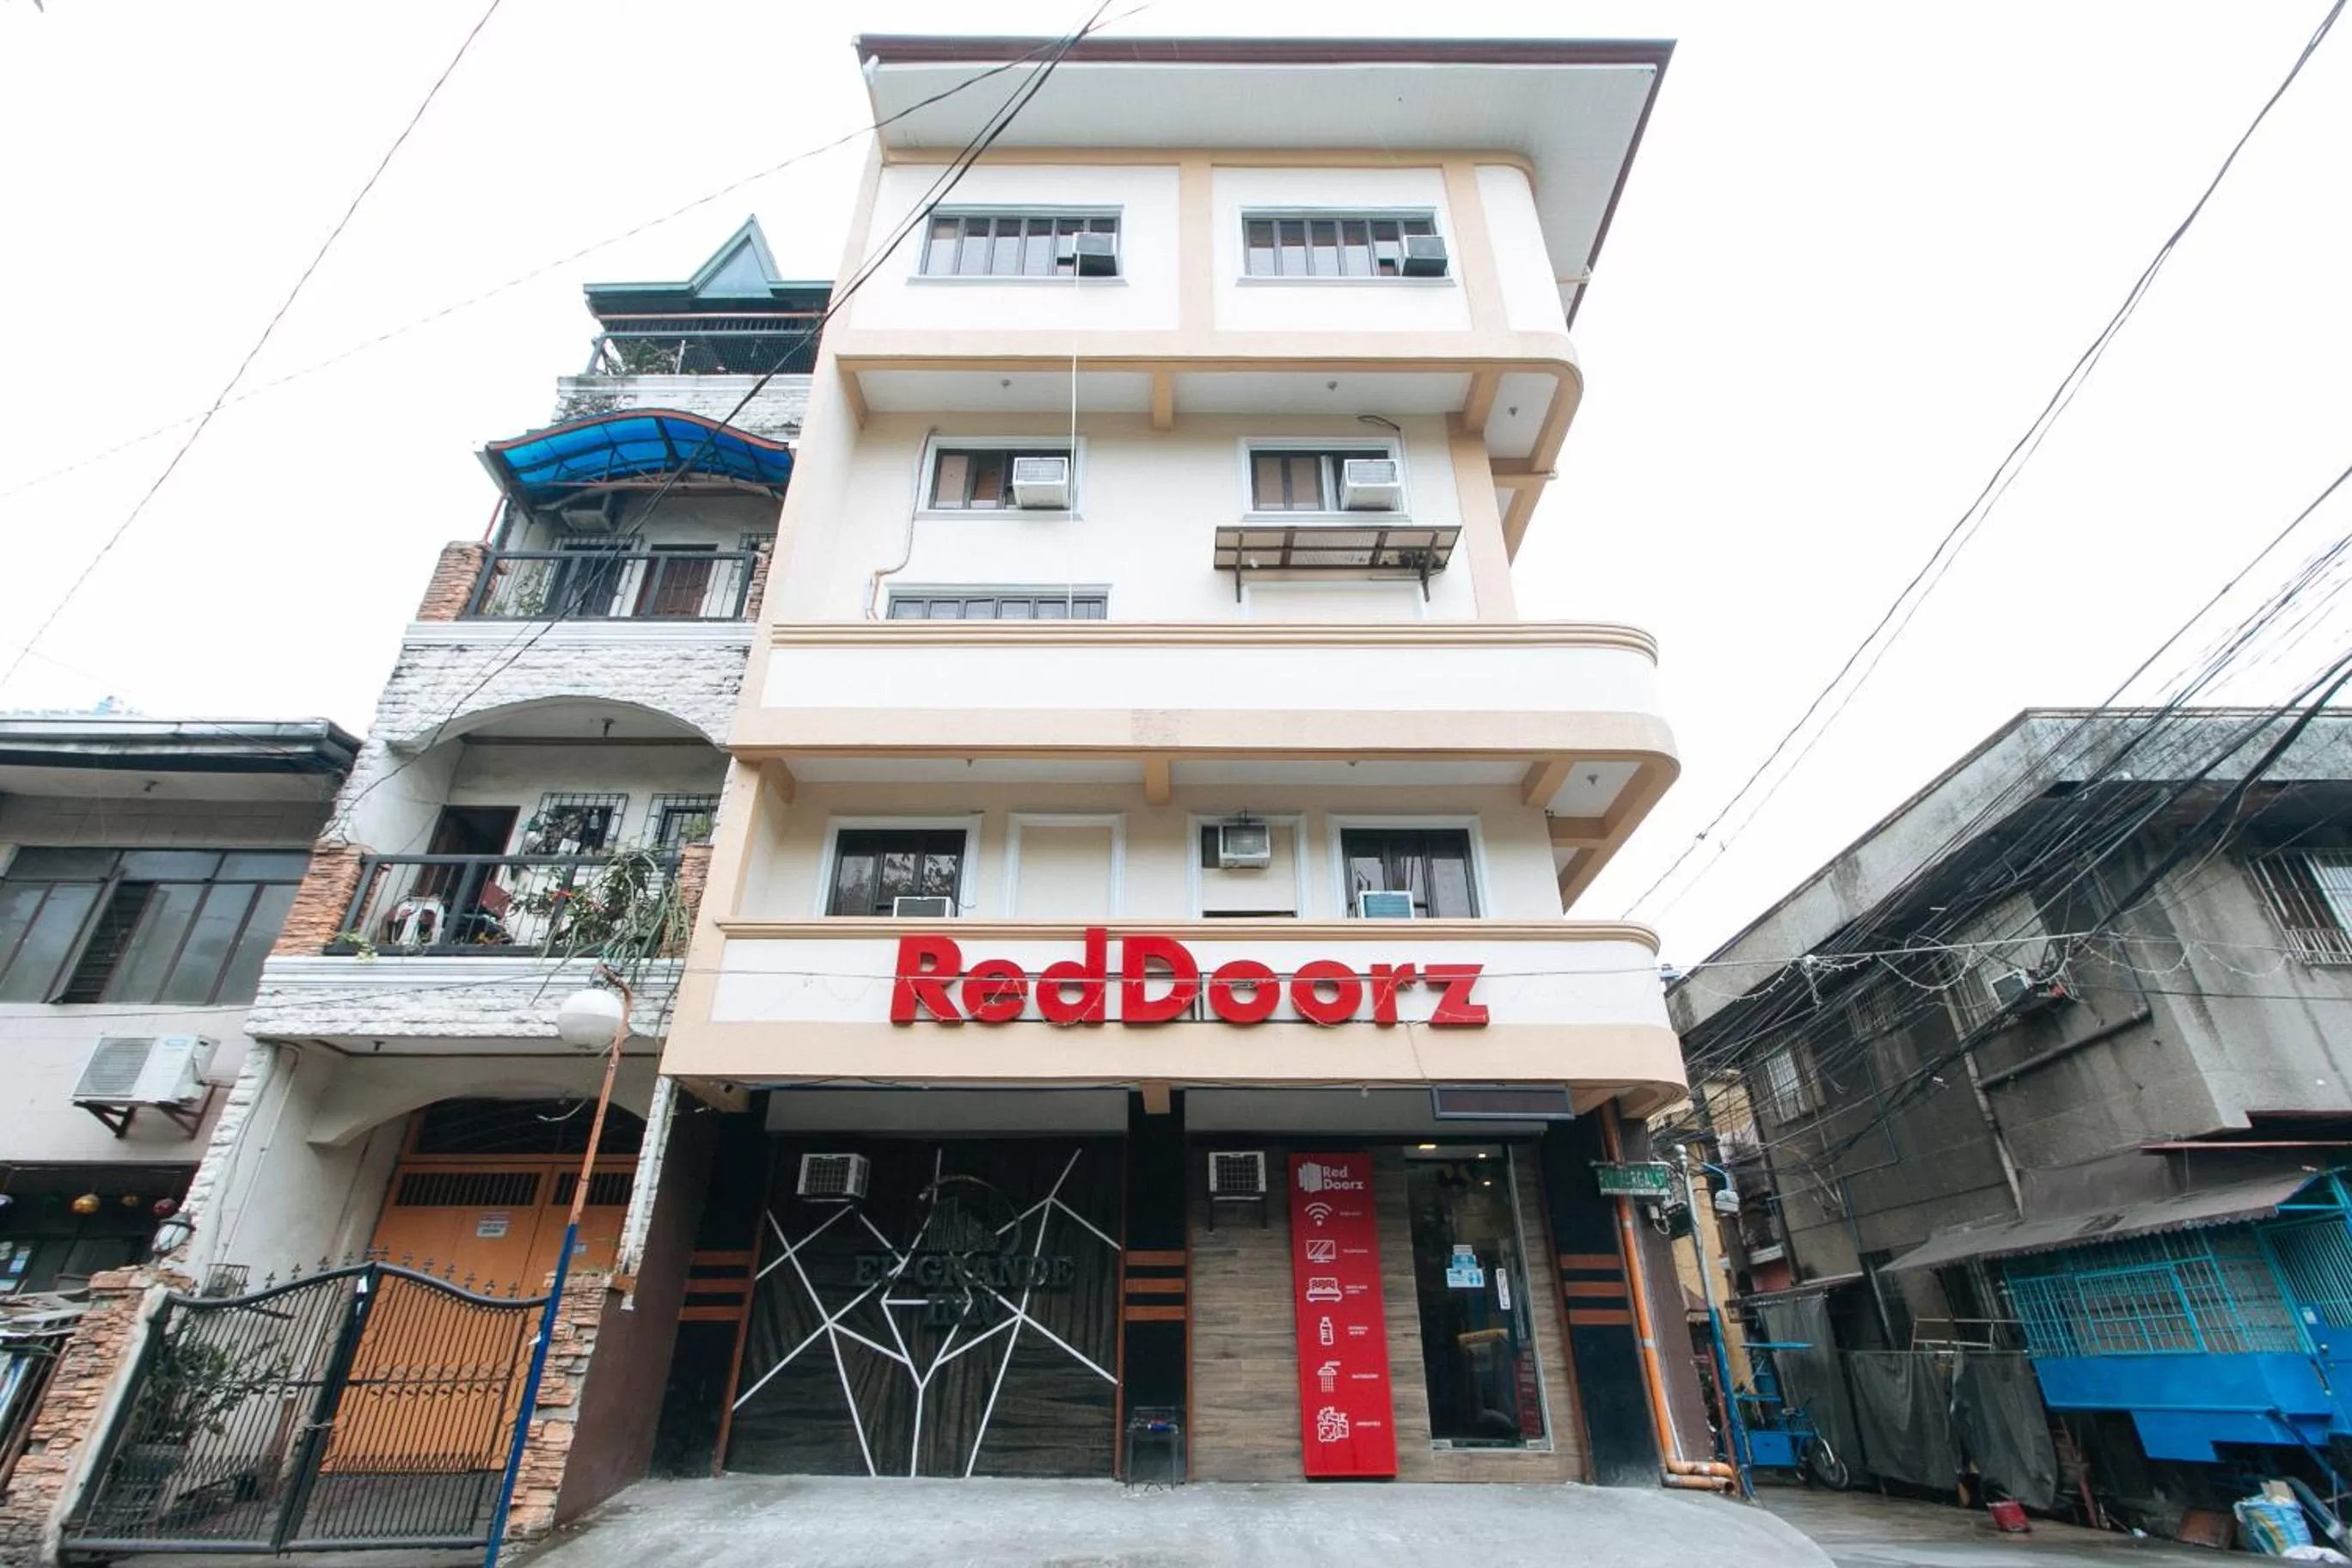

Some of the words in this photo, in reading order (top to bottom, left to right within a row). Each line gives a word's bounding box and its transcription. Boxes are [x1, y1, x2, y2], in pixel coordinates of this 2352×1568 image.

[890, 928, 1490, 1027] RedDoorz
[1322, 1164, 1348, 1179] Red
[1322, 1178, 1365, 1191] Doorz
[922, 1292, 995, 1325] INN
